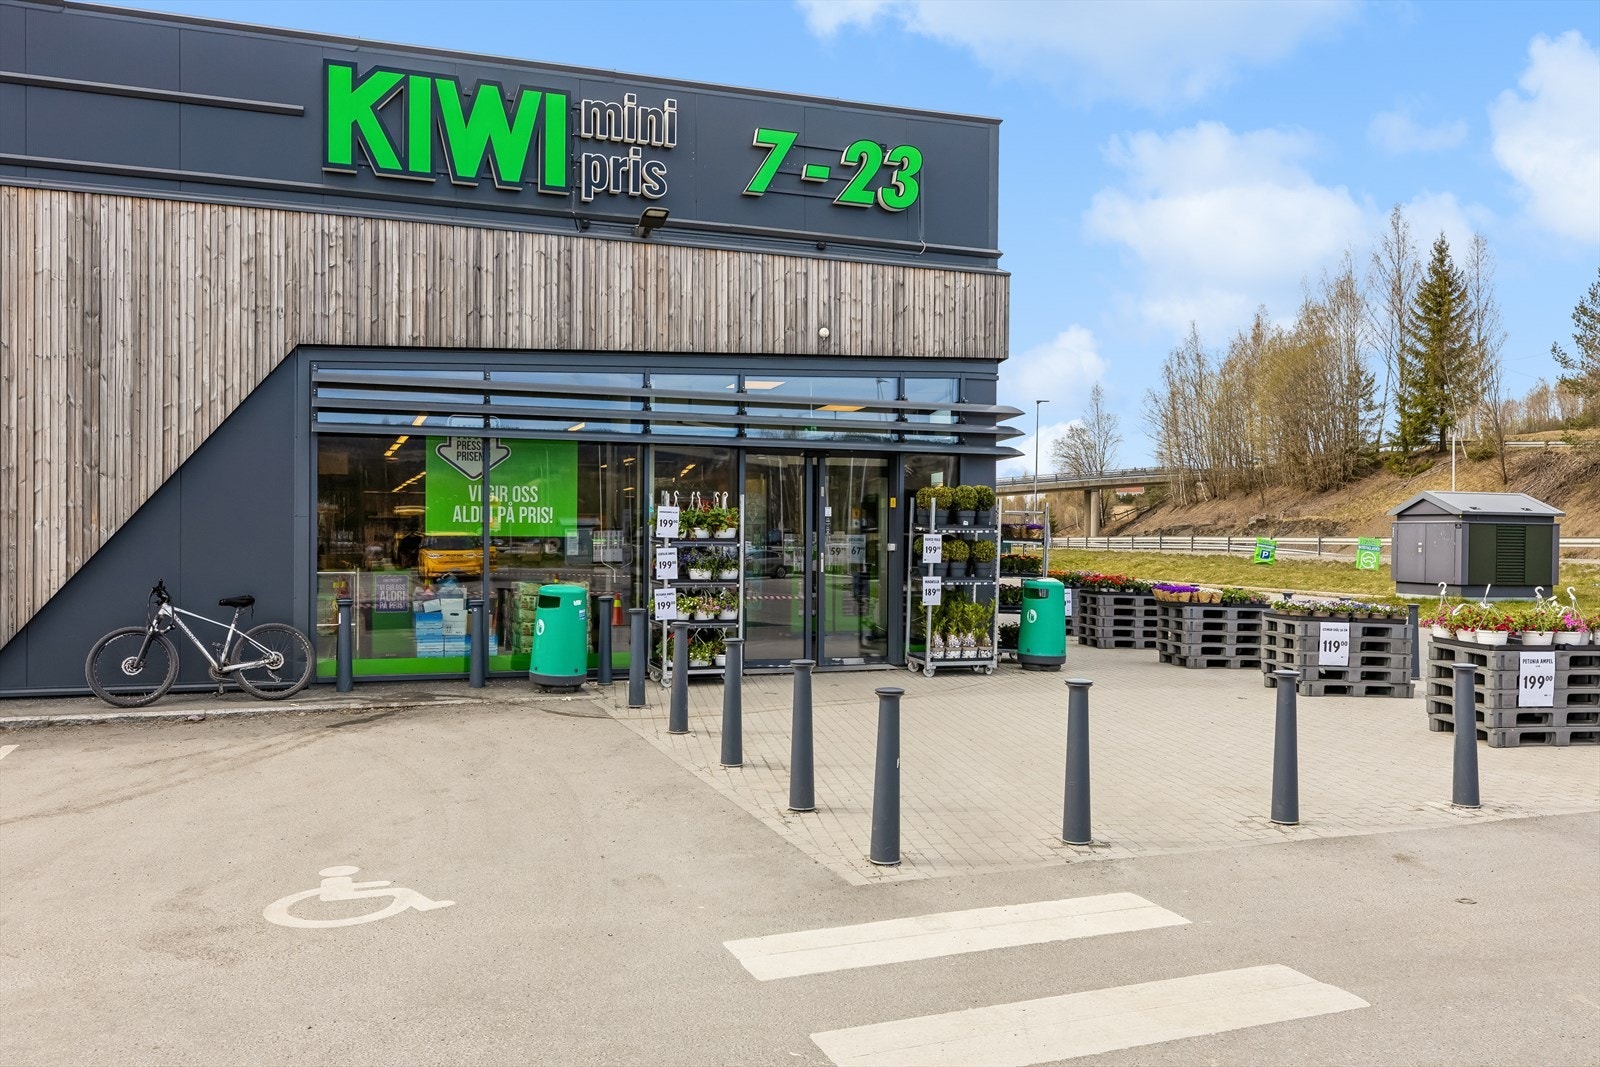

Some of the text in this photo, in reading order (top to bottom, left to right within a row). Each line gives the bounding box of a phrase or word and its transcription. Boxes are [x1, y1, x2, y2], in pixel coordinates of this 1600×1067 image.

[323, 61, 570, 194] KIWI
[581, 93, 677, 148] mini
[581, 147, 668, 202] pris
[743, 127, 798, 196] 7
[833, 140, 924, 212] 23
[456, 440, 482, 451] PRESS
[468, 485, 481, 502] VI
[512, 486, 538, 503] OSS
[498, 501, 515, 523] PÅ
[519, 507, 553, 523] PRIS!
[659, 519, 673, 528] 199
[925, 546, 937, 554] 199
[659, 561, 672, 569] 199
[924, 588, 937, 596] 189
[657, 601, 671, 610] 199
[1323, 640, 1340, 653] 119
[1523, 675, 1545, 690] 199
